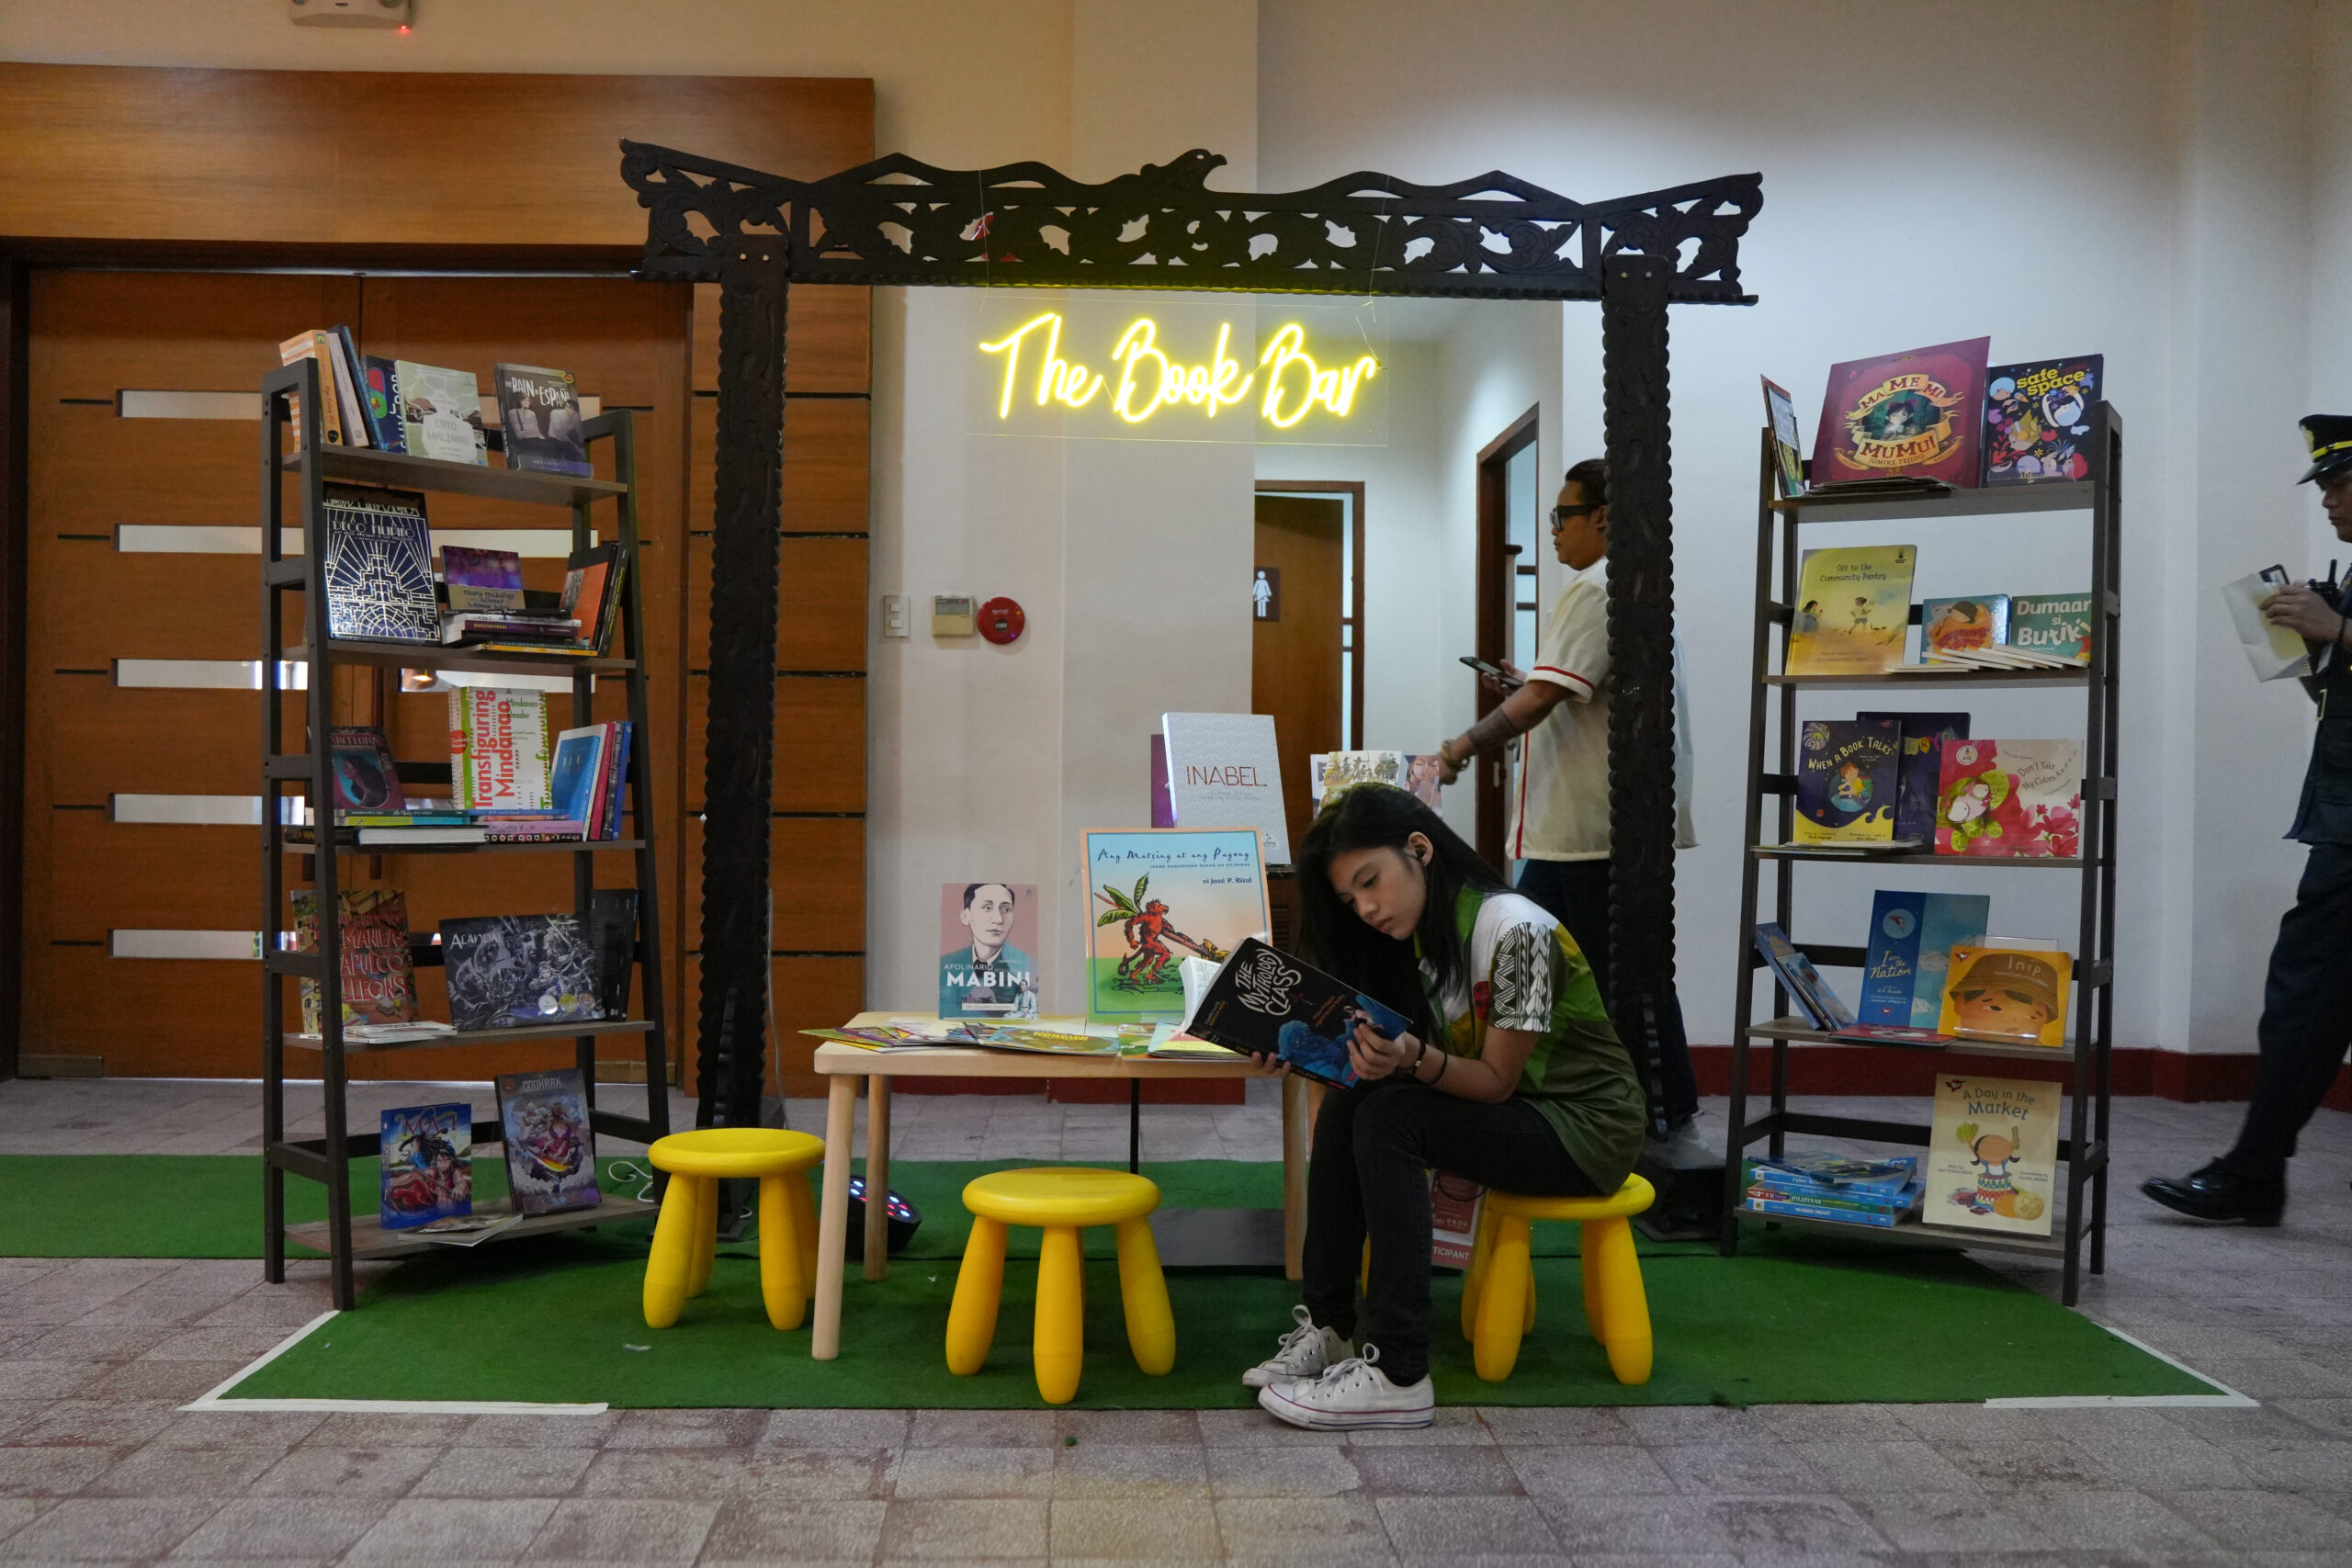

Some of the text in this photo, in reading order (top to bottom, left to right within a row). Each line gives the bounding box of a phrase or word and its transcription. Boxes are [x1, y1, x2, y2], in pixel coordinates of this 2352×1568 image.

[978, 310, 1377, 429] The Book Bar
[2017, 368, 2059, 389] safe
[511, 377, 535, 397] RAIN
[538, 386, 571, 407] ESPAÑA
[1860, 377, 1944, 409] MA ME MI
[2027, 371, 2085, 396] space
[1860, 435, 1937, 459] MUMU!
[333, 520, 367, 533] DECO
[1820, 573, 1887, 582] Community Pantry
[2052, 615, 2062, 625] si
[506, 698, 538, 707] Mindanao
[470, 690, 498, 809] Transfiguring
[492, 700, 515, 797] Mindanao
[1808, 736, 1892, 770] WHEN A BOOK TALKS
[1186, 766, 1268, 787] INABEL
[1097, 848, 1121, 863] Ang
[1127, 850, 1171, 863] Matsing
[1192, 852, 1208, 863] ang
[1213, 846, 1250, 861] Pagong
[341, 953, 404, 976] APULCO
[1880, 950, 1891, 967] I
[2008, 955, 2041, 976] Inip
[946, 971, 1030, 987] MABINI
[1235, 960, 1254, 990] THE
[1237, 948, 1283, 1013] MYTHOLOGY
[1869, 964, 1911, 980] Nation
[1265, 965, 1302, 1016] CLASS
[1963, 1088, 2035, 1105] A Day in the
[1968, 1101, 2029, 1120] Market
[1433, 1247, 1470, 1260] TICIPANT
